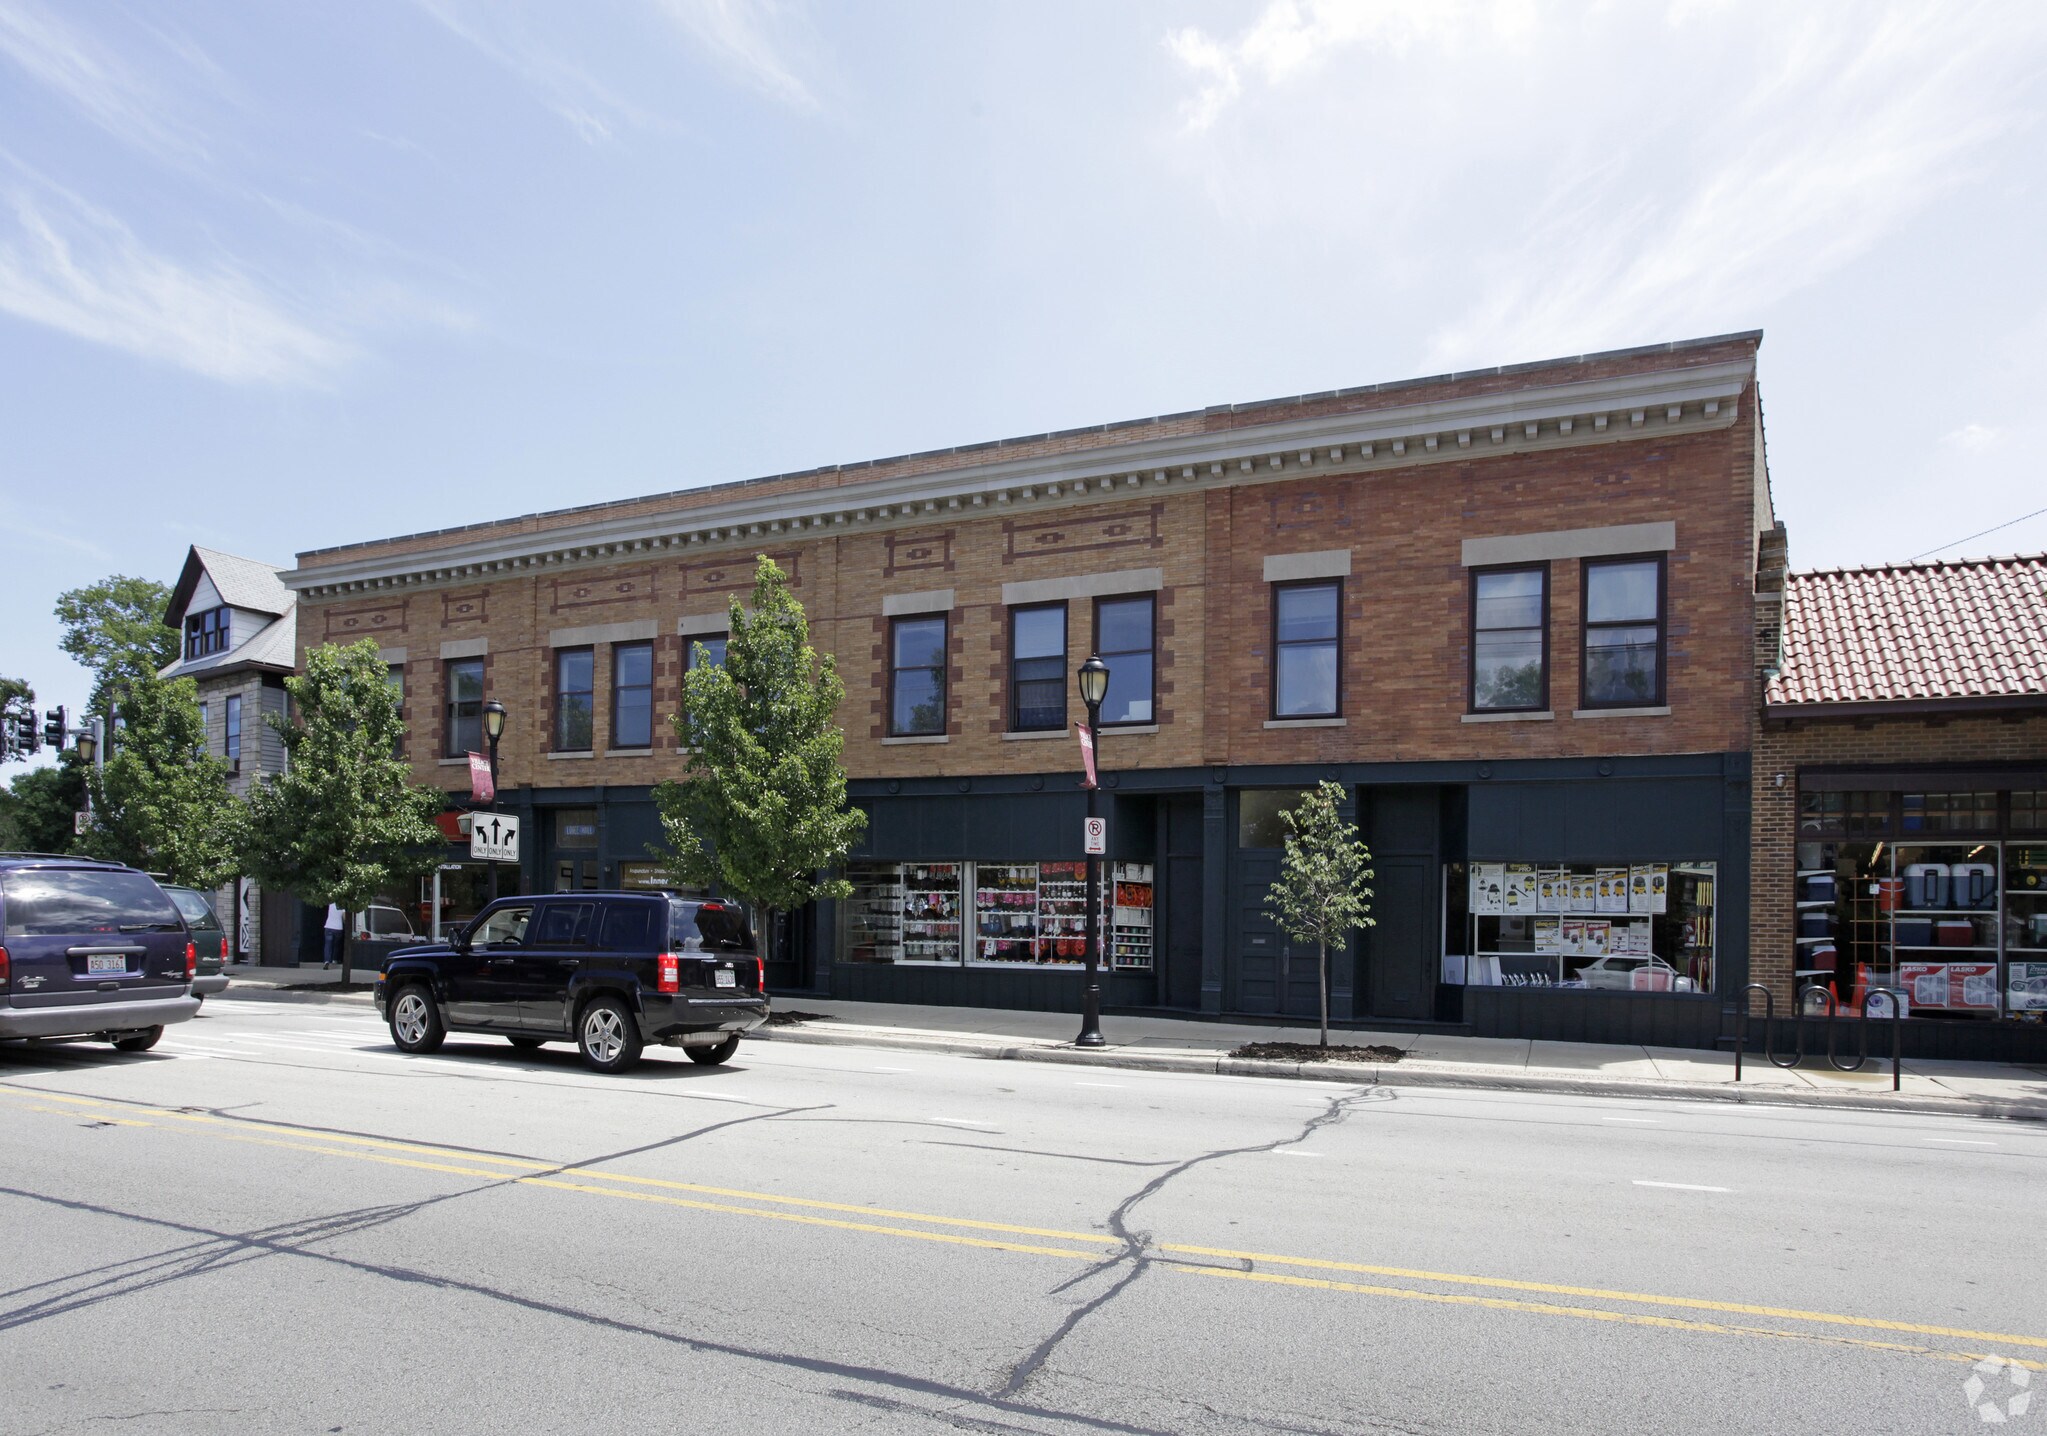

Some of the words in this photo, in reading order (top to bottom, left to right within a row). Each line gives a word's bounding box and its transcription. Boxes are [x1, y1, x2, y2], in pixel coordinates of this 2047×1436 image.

[473, 846, 487, 854] ONLY
[489, 847, 502, 856] ONLY
[503, 848, 516, 857] ONLY
[106, 960, 125, 970] 3161
